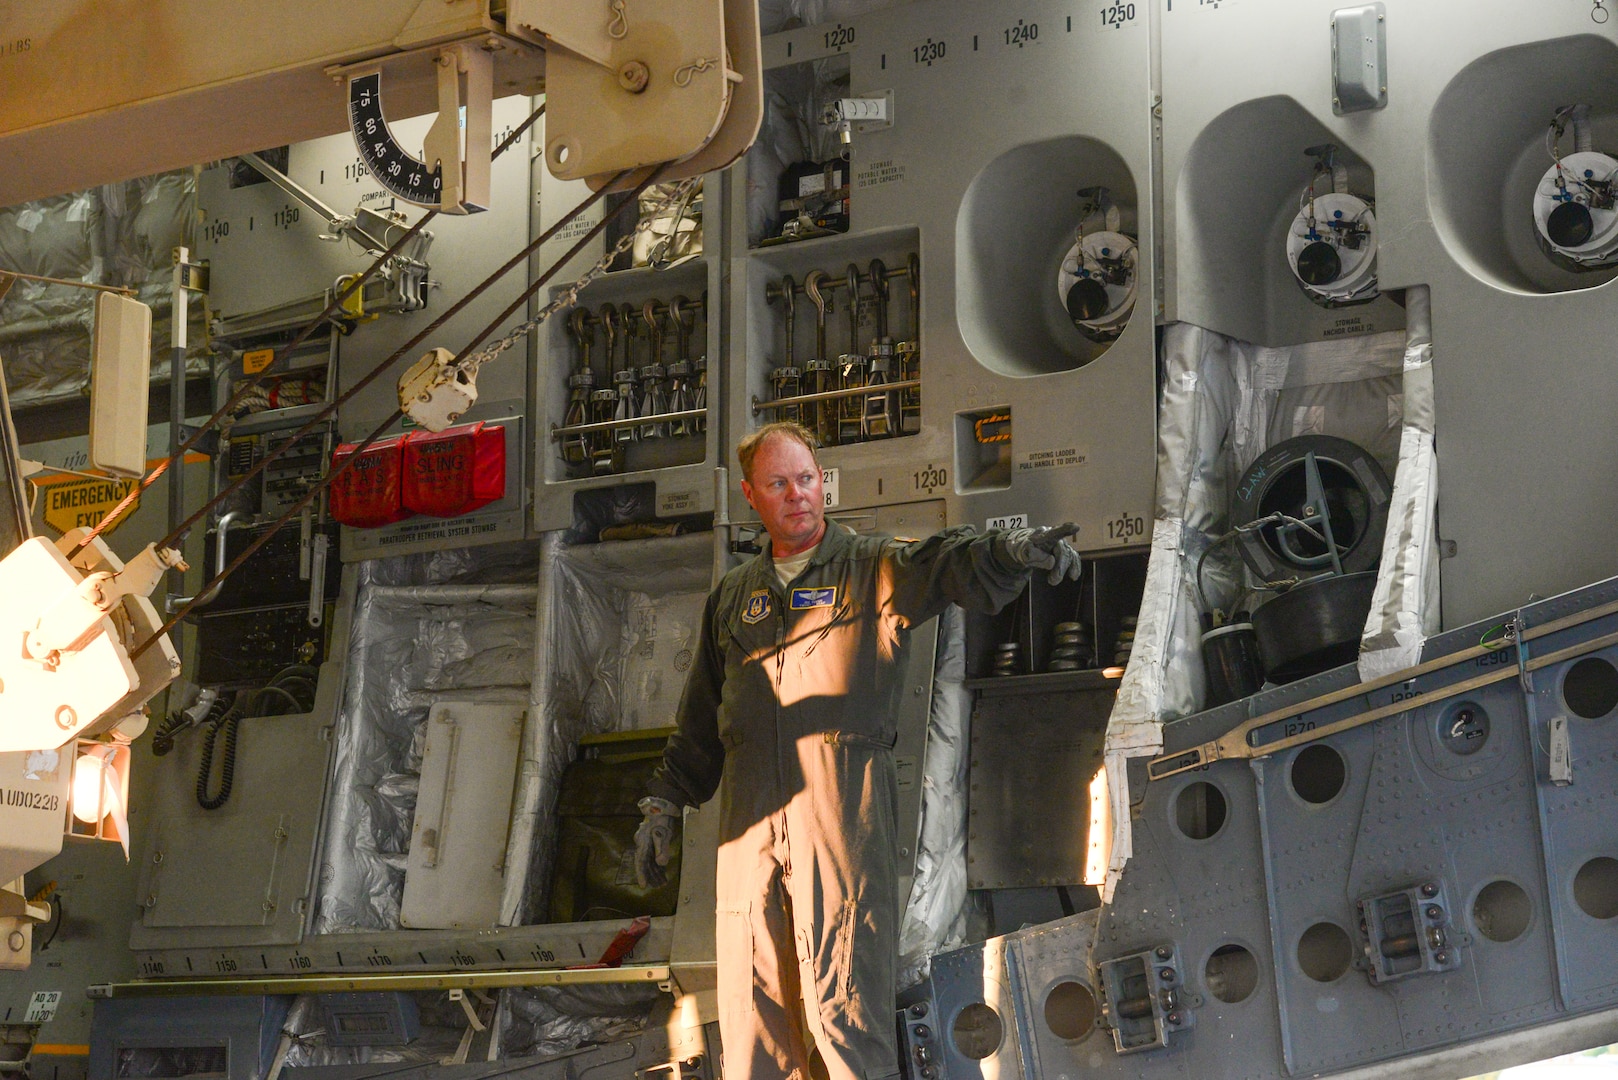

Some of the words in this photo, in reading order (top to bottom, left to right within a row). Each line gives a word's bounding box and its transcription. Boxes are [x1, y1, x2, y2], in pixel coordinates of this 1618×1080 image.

[1100, 3, 1136, 26] 1250
[824, 27, 855, 48] 1220
[1004, 23, 1039, 45] 1240
[913, 41, 946, 63] 1230
[360, 88, 371, 107] 75
[365, 117, 377, 135] 60
[374, 142, 387, 158] 45
[387, 160, 401, 176] 30
[408, 172, 421, 187] 15
[433, 176, 441, 190] 0
[274, 208, 299, 226] 1150
[204, 222, 229, 241] 1140
[1020, 461, 1033, 470] PULL
[1034, 459, 1055, 468] HANDLE
[1057, 457, 1064, 466] TO
[1065, 455, 1086, 465] DEPLOY
[1029, 451, 1054, 461] DITCHING
[1055, 448, 1076, 458] LADDER
[416, 453, 464, 474] SLING
[914, 468, 947, 490] 1230
[52, 481, 132, 510] EMERGENCY
[1010, 517, 1023, 529] 22
[1107, 517, 1143, 539] 1250
[379, 533, 417, 545] PARATROOPER
[448, 526, 471, 537] SYSTEM
[472, 522, 497, 535] STOWAGE
[289, 956, 312, 970] 1160
[367, 955, 392, 967] 1170
[450, 955, 475, 967] 1180
[530, 950, 555, 963] 1190
[143, 962, 164, 975] 1140
[216, 960, 237, 973] 1150
[47, 993, 58, 1003] 20
